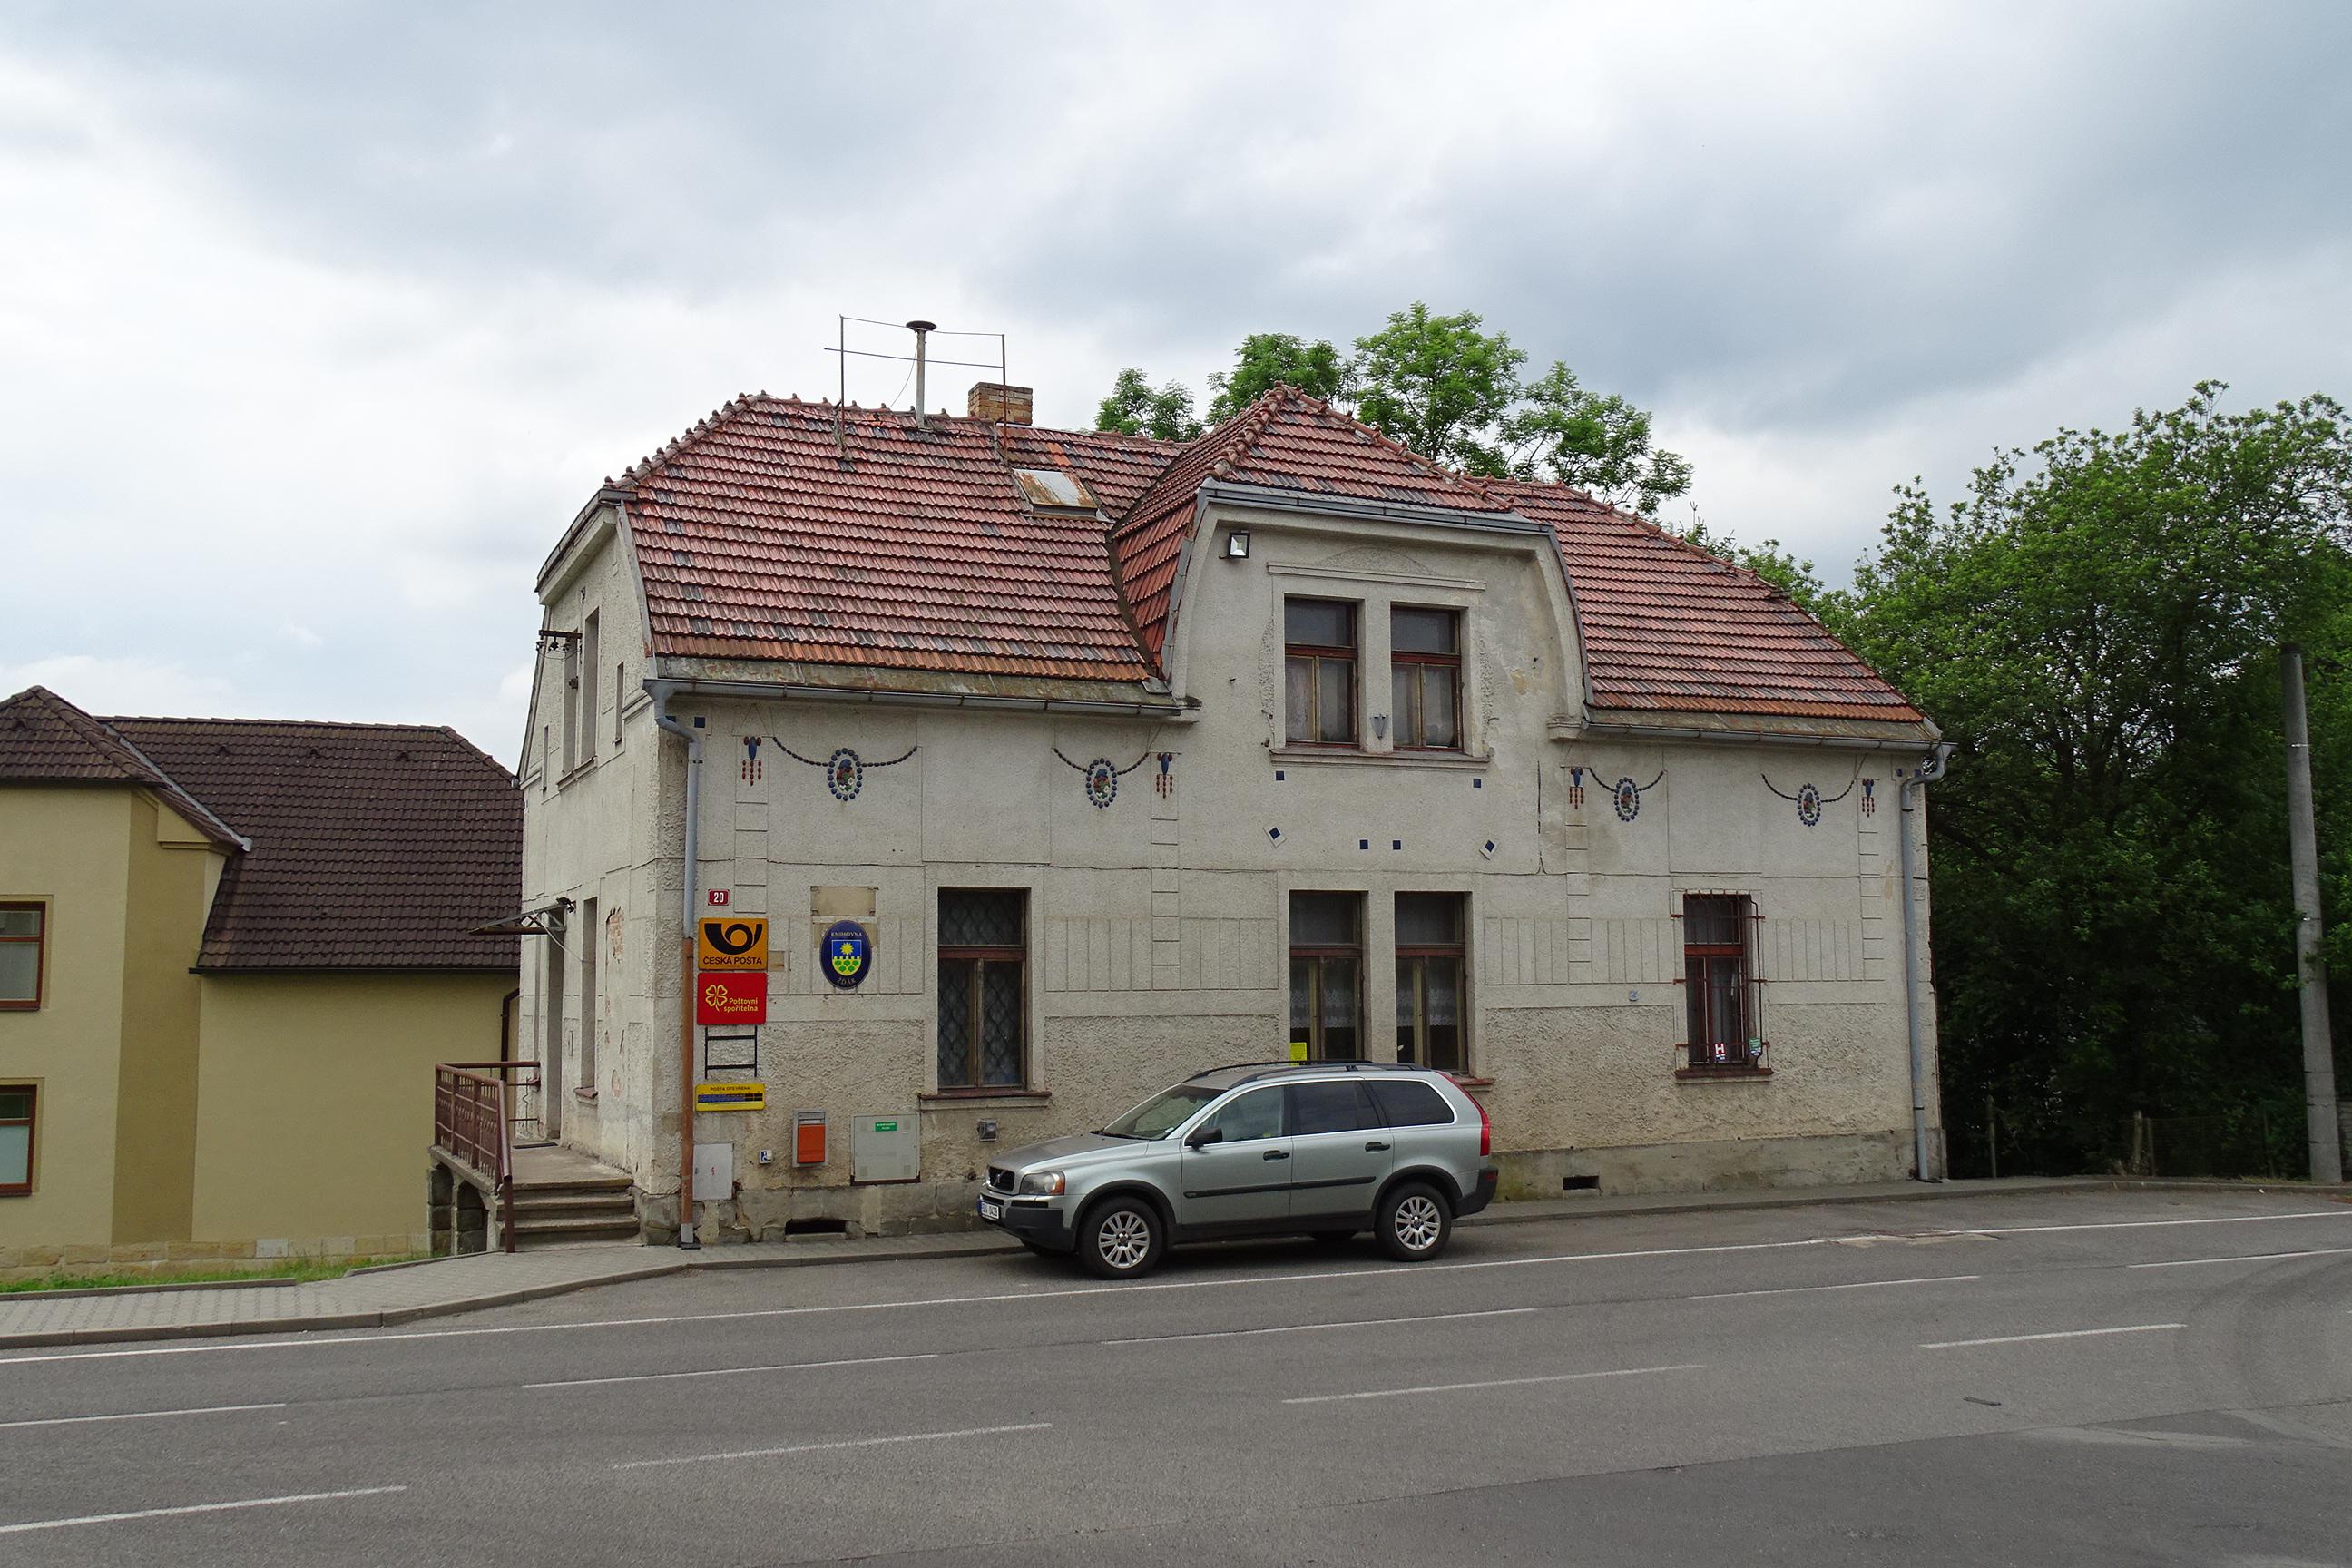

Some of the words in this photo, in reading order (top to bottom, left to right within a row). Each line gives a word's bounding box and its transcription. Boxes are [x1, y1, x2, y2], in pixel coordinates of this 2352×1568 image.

[713, 892, 724, 903] 20
[702, 956, 732, 965] ČESKÁ
[734, 956, 762, 965] POŠTA
[723, 1004, 759, 1013] spořitelna
